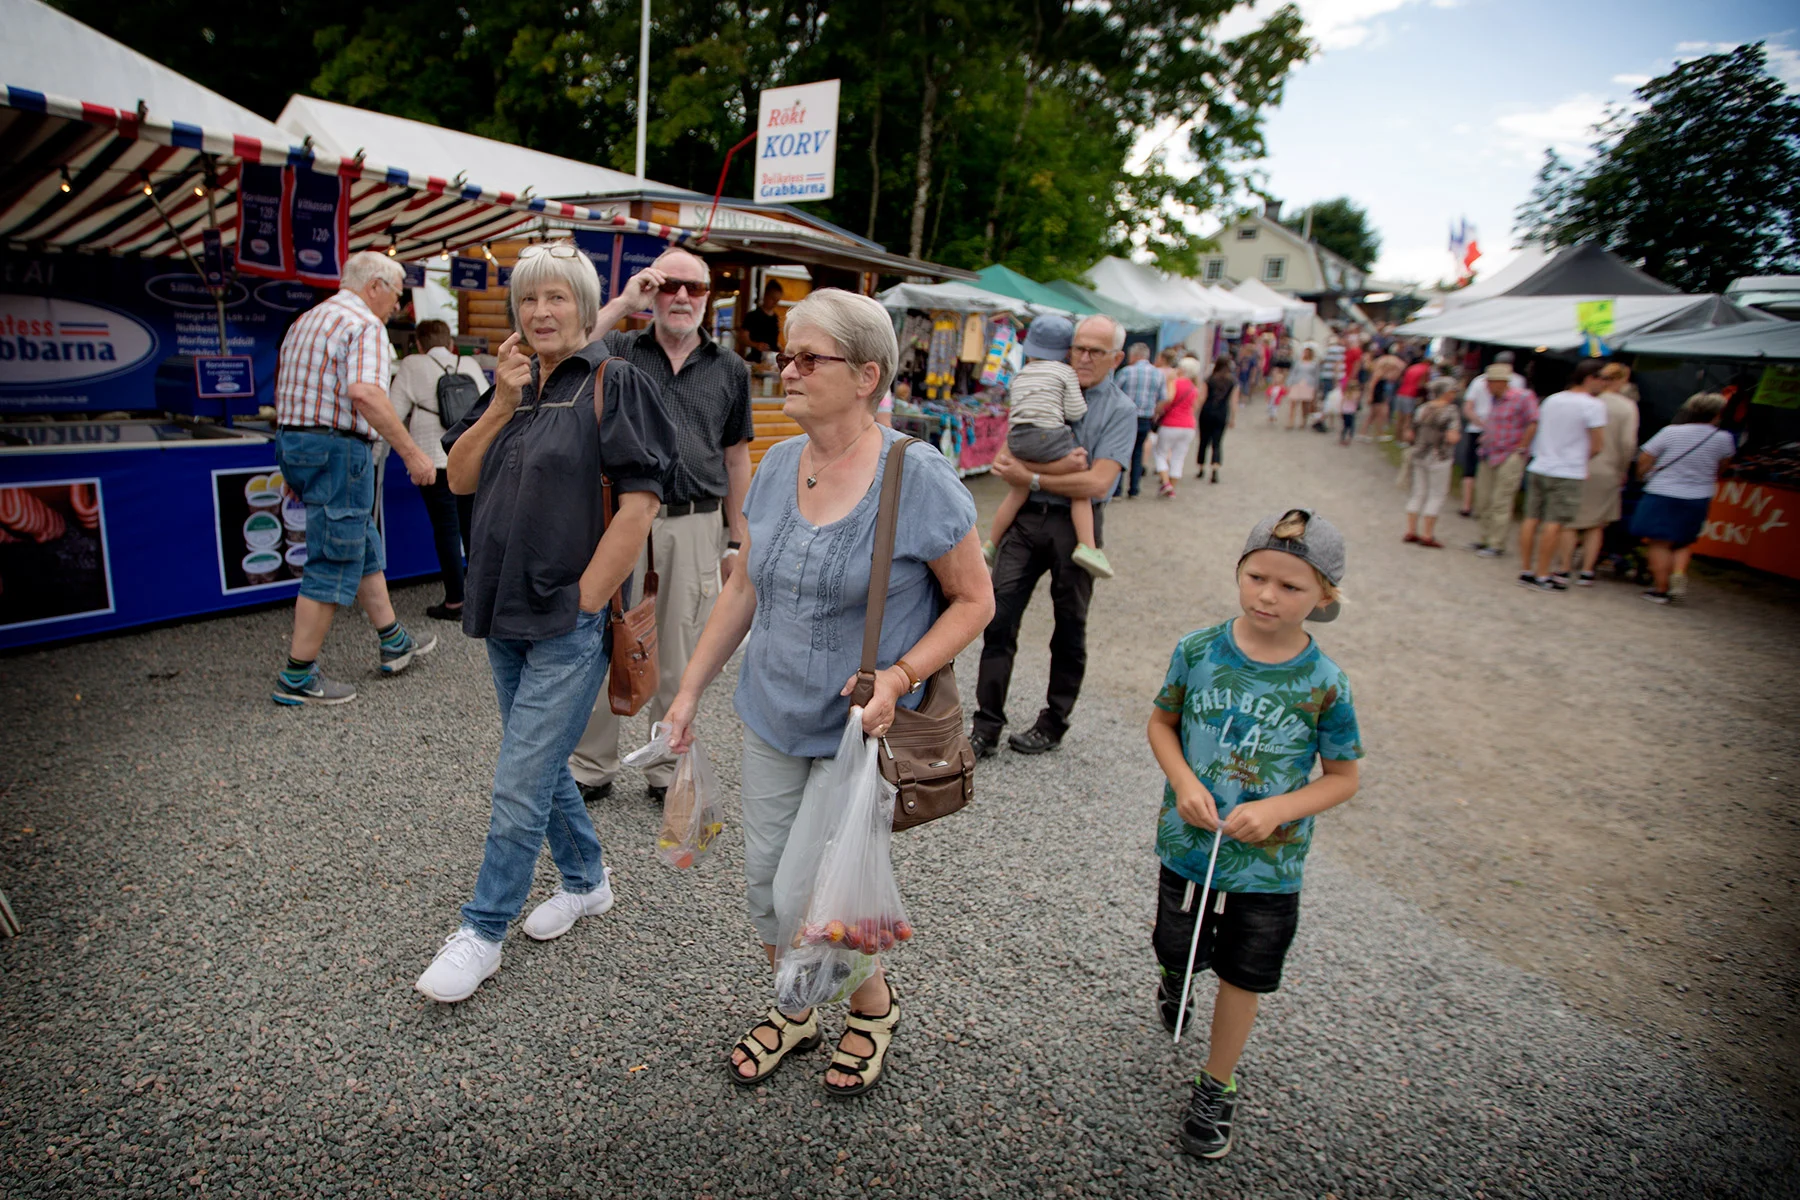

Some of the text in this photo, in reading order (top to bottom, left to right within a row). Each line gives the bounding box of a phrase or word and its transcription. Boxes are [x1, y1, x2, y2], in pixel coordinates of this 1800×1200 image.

[767, 107, 806, 128] Rökt
[761, 129, 831, 159] KORV
[760, 182, 826, 198] Grabbarna
[1715, 480, 1789, 533] NNY
[1192, 688, 1310, 741] CALI BEACH
[1200, 722, 1221, 736] WEST
[1258, 743, 1284, 754] COAST
[1238, 760, 1260, 774] CLUB
